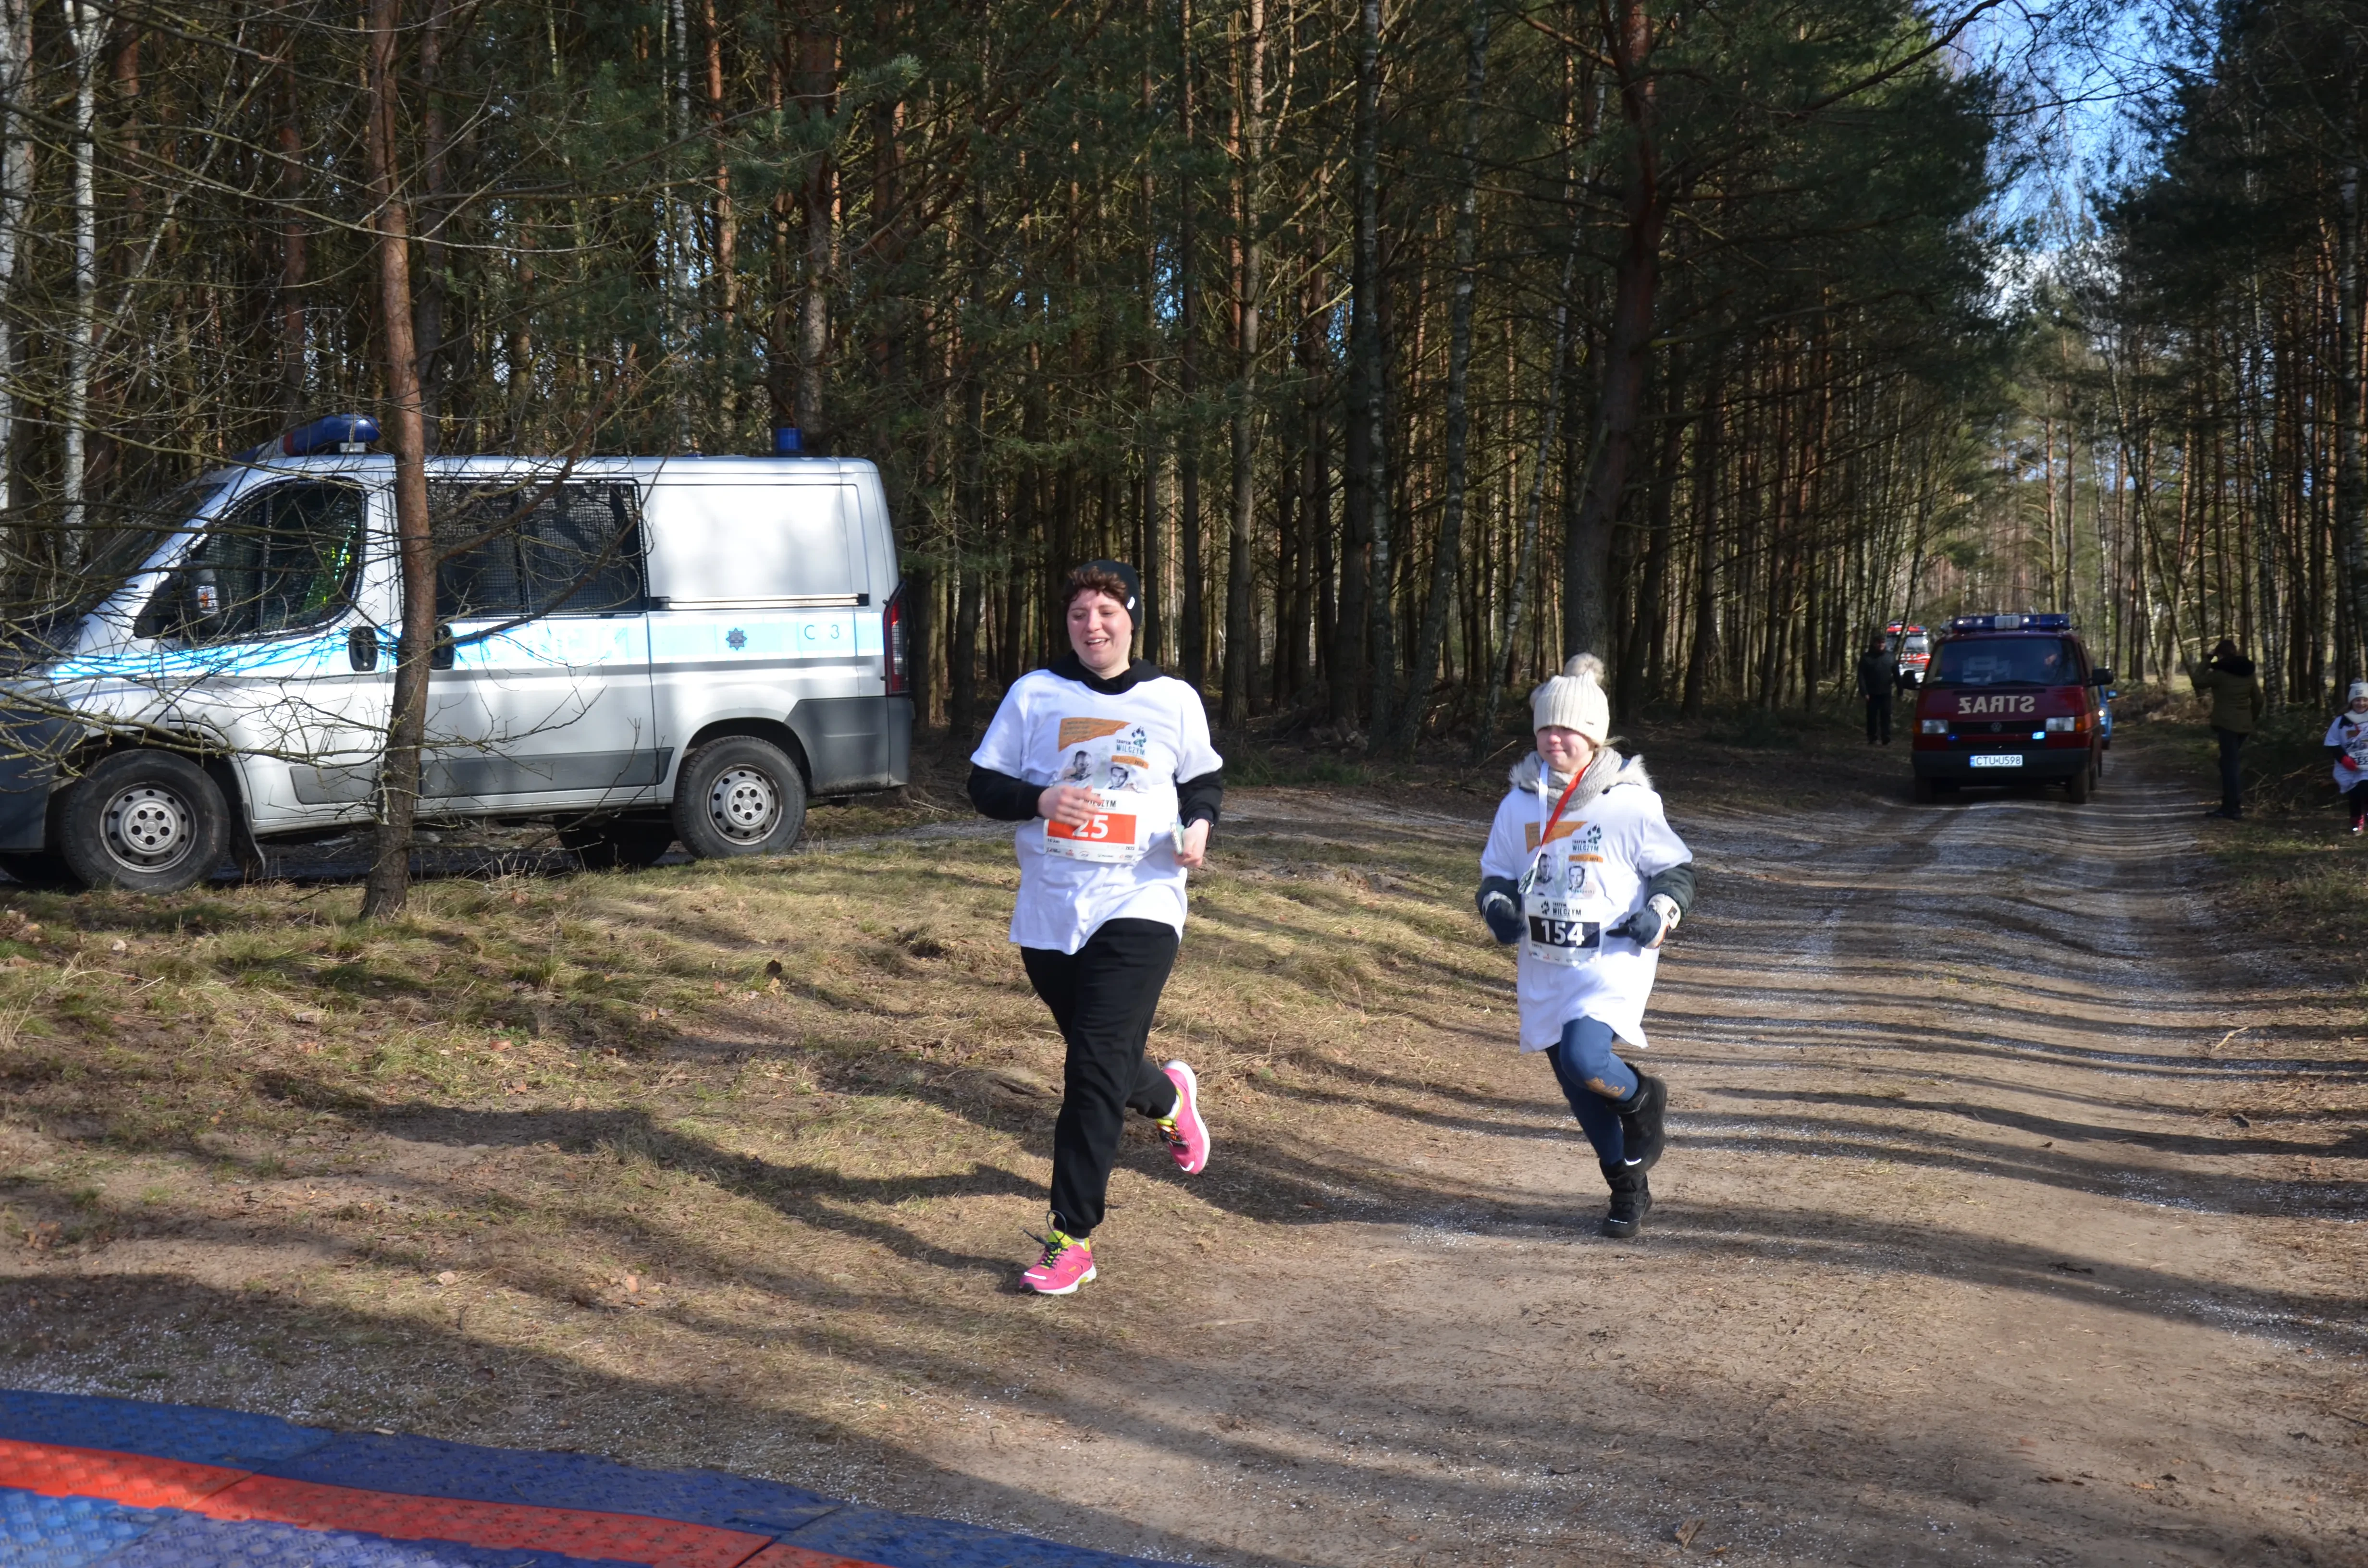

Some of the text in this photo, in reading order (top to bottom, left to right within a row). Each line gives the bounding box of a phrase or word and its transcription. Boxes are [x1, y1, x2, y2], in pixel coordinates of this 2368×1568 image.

[1116, 744, 1146, 756] WILCZYM
[1976, 756, 2021, 765] CTU U598
[1072, 814, 1109, 839] 25
[1553, 907, 1582, 917] WILCZYM
[1541, 919, 1585, 947] 154
